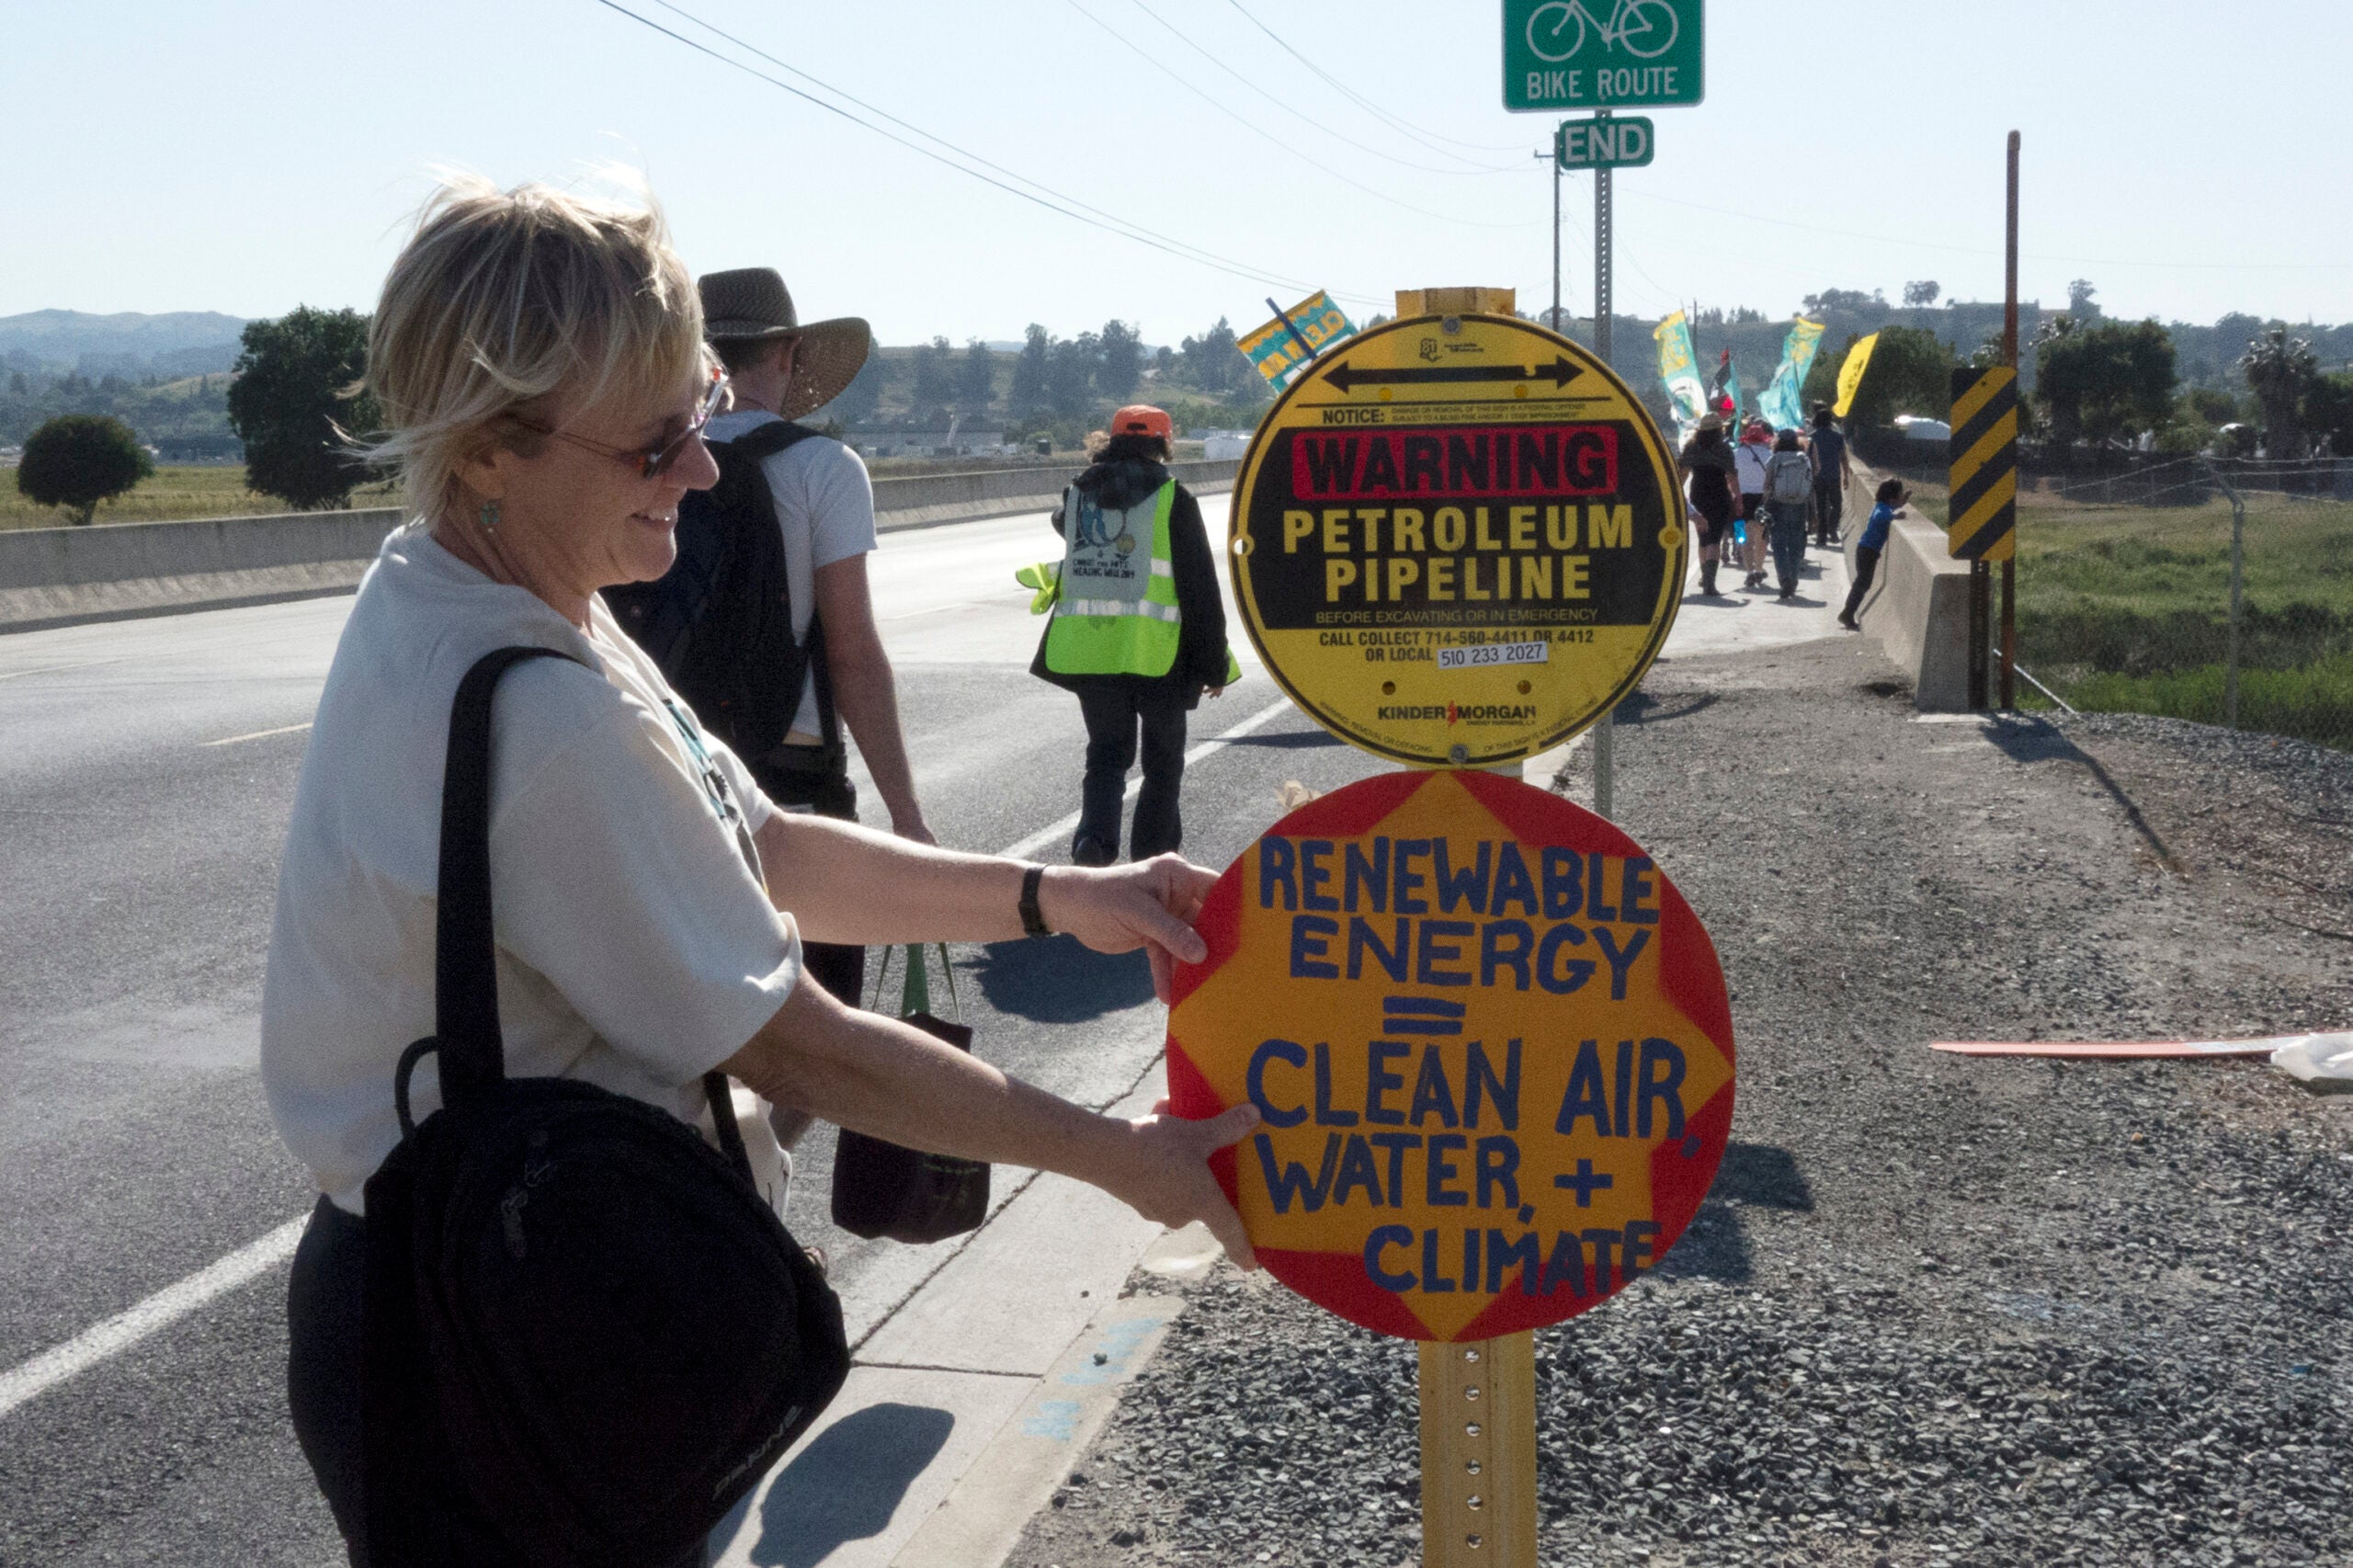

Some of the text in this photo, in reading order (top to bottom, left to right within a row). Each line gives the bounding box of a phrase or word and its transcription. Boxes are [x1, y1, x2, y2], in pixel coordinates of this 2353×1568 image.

[1527, 66, 1678, 100] BIKE ROUTE
[1565, 124, 1647, 163] END
[1323, 409, 1384, 424] NOTICE:
[1304, 432, 1609, 493] WARNING
[1284, 506, 1632, 553] PETROLEUM
[1325, 555, 1590, 602] PIPELINE
[1316, 608, 1598, 624] BEFORE EXCAVATING OR IN EMERGENCY
[1320, 632, 1353, 645] CALL
[1358, 631, 1421, 645] COLLECT
[1533, 630, 1552, 643] OR
[1558, 630, 1594, 642] 4412
[1366, 644, 1542, 666] OR LOCAL 510 233 2027
[1379, 705, 1536, 721] KINDER MORGAN
[1259, 836, 1659, 924] RENEWABLE
[1290, 915, 1653, 1001] ENERGY
[1245, 1038, 1702, 1159] CLEAN AIR,
[1254, 1132, 1613, 1225] WATER, +
[1364, 1220, 1663, 1299] CLIMATE
